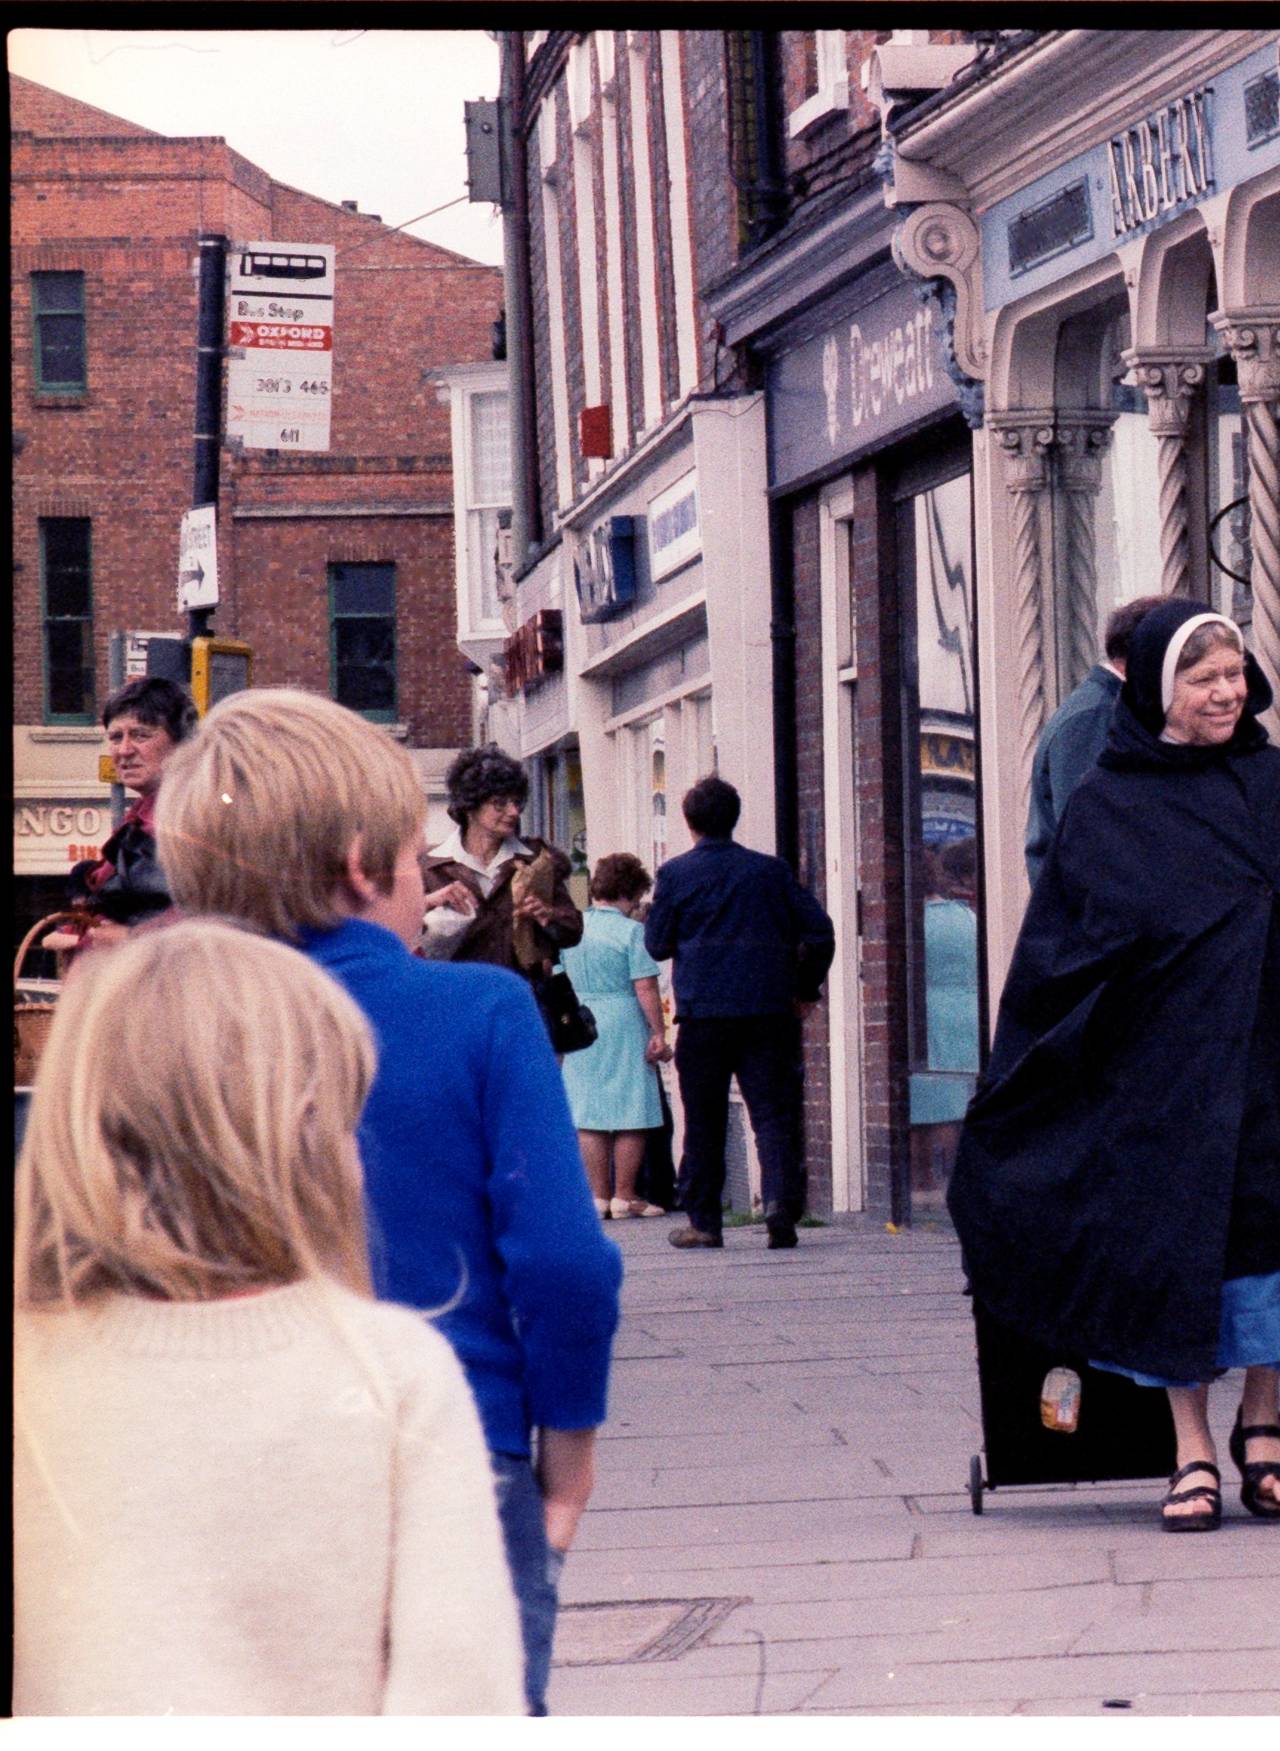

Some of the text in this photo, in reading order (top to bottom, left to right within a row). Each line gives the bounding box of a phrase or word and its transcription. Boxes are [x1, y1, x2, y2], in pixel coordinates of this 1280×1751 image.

[1106, 88, 1209, 239] ARBERY
[268, 303, 304, 321] Stop
[257, 325, 325, 340] OXFORD
